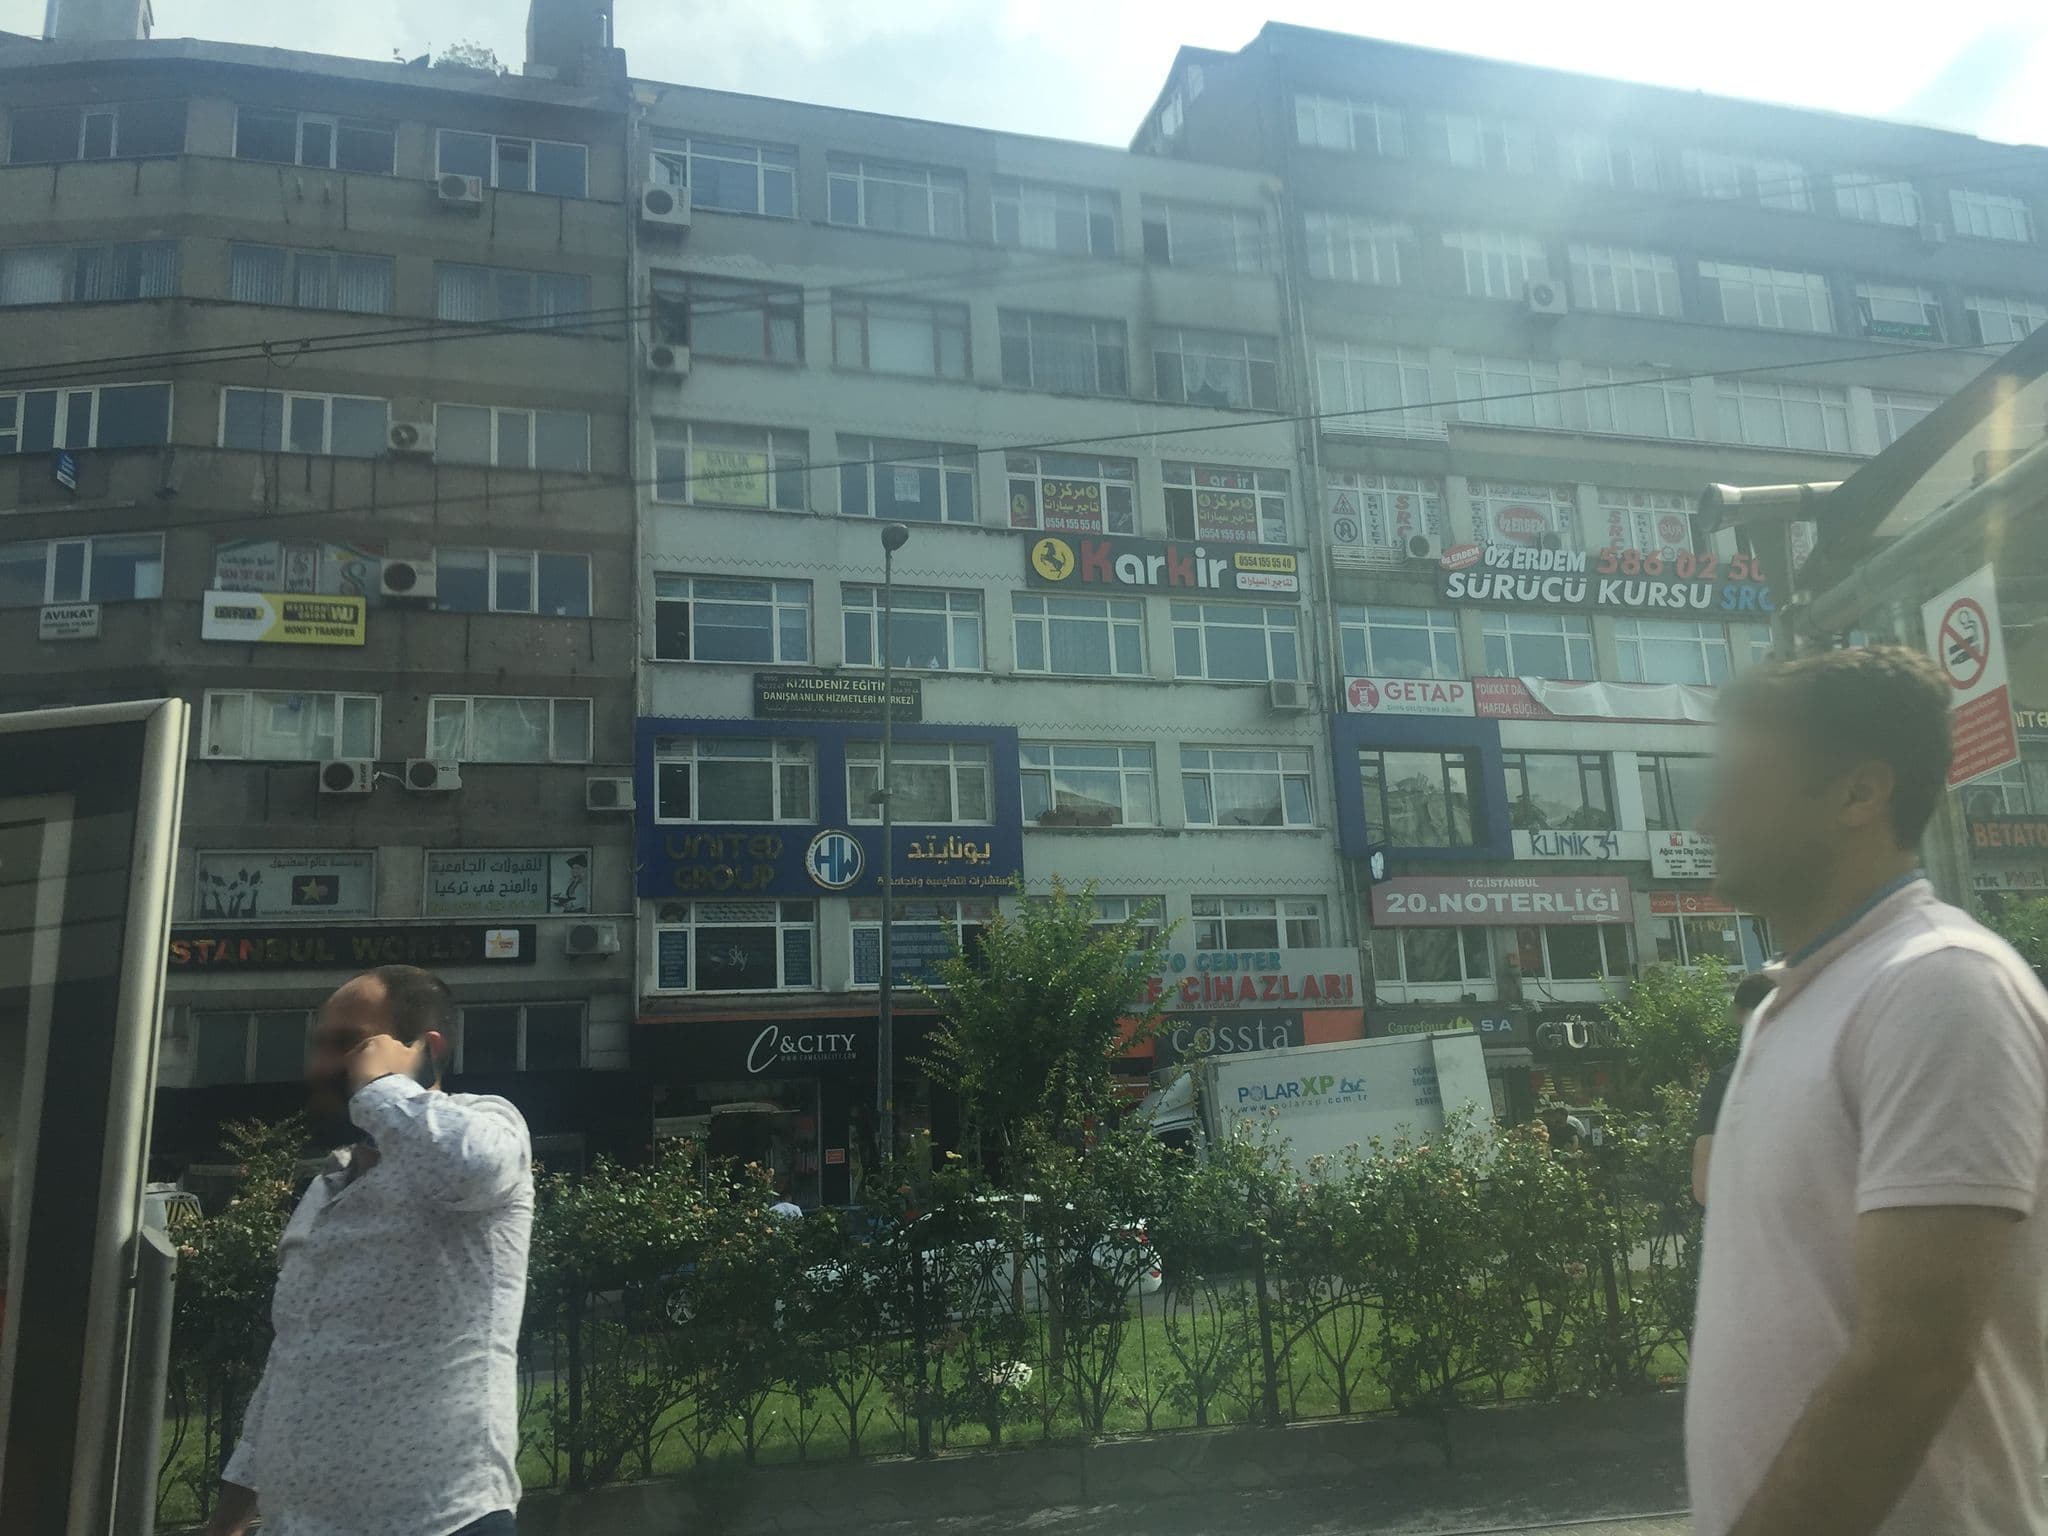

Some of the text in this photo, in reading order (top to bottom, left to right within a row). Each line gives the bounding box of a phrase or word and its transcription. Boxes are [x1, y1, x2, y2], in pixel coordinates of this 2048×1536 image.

[1239, 555, 1292, 569] 0554 155 55 40
[1596, 549, 1664, 575] 586
[1677, 553, 1718, 579] 02
[1446, 571, 1588, 603] SÜRÜCÜ
[1598, 580, 1713, 609] KURSU
[45, 609, 96, 621] AVUKAT
[878, 695, 915, 705] MRKEZİ
[1384, 681, 1465, 703] GETAP
[1531, 832, 1593, 857] KLİNİK
[1385, 888, 1622, 914] 20.NOTERLİĞİ
[1195, 952, 1282, 973] CENTER
[1182, 972, 1354, 1004] CİHAZLARI
